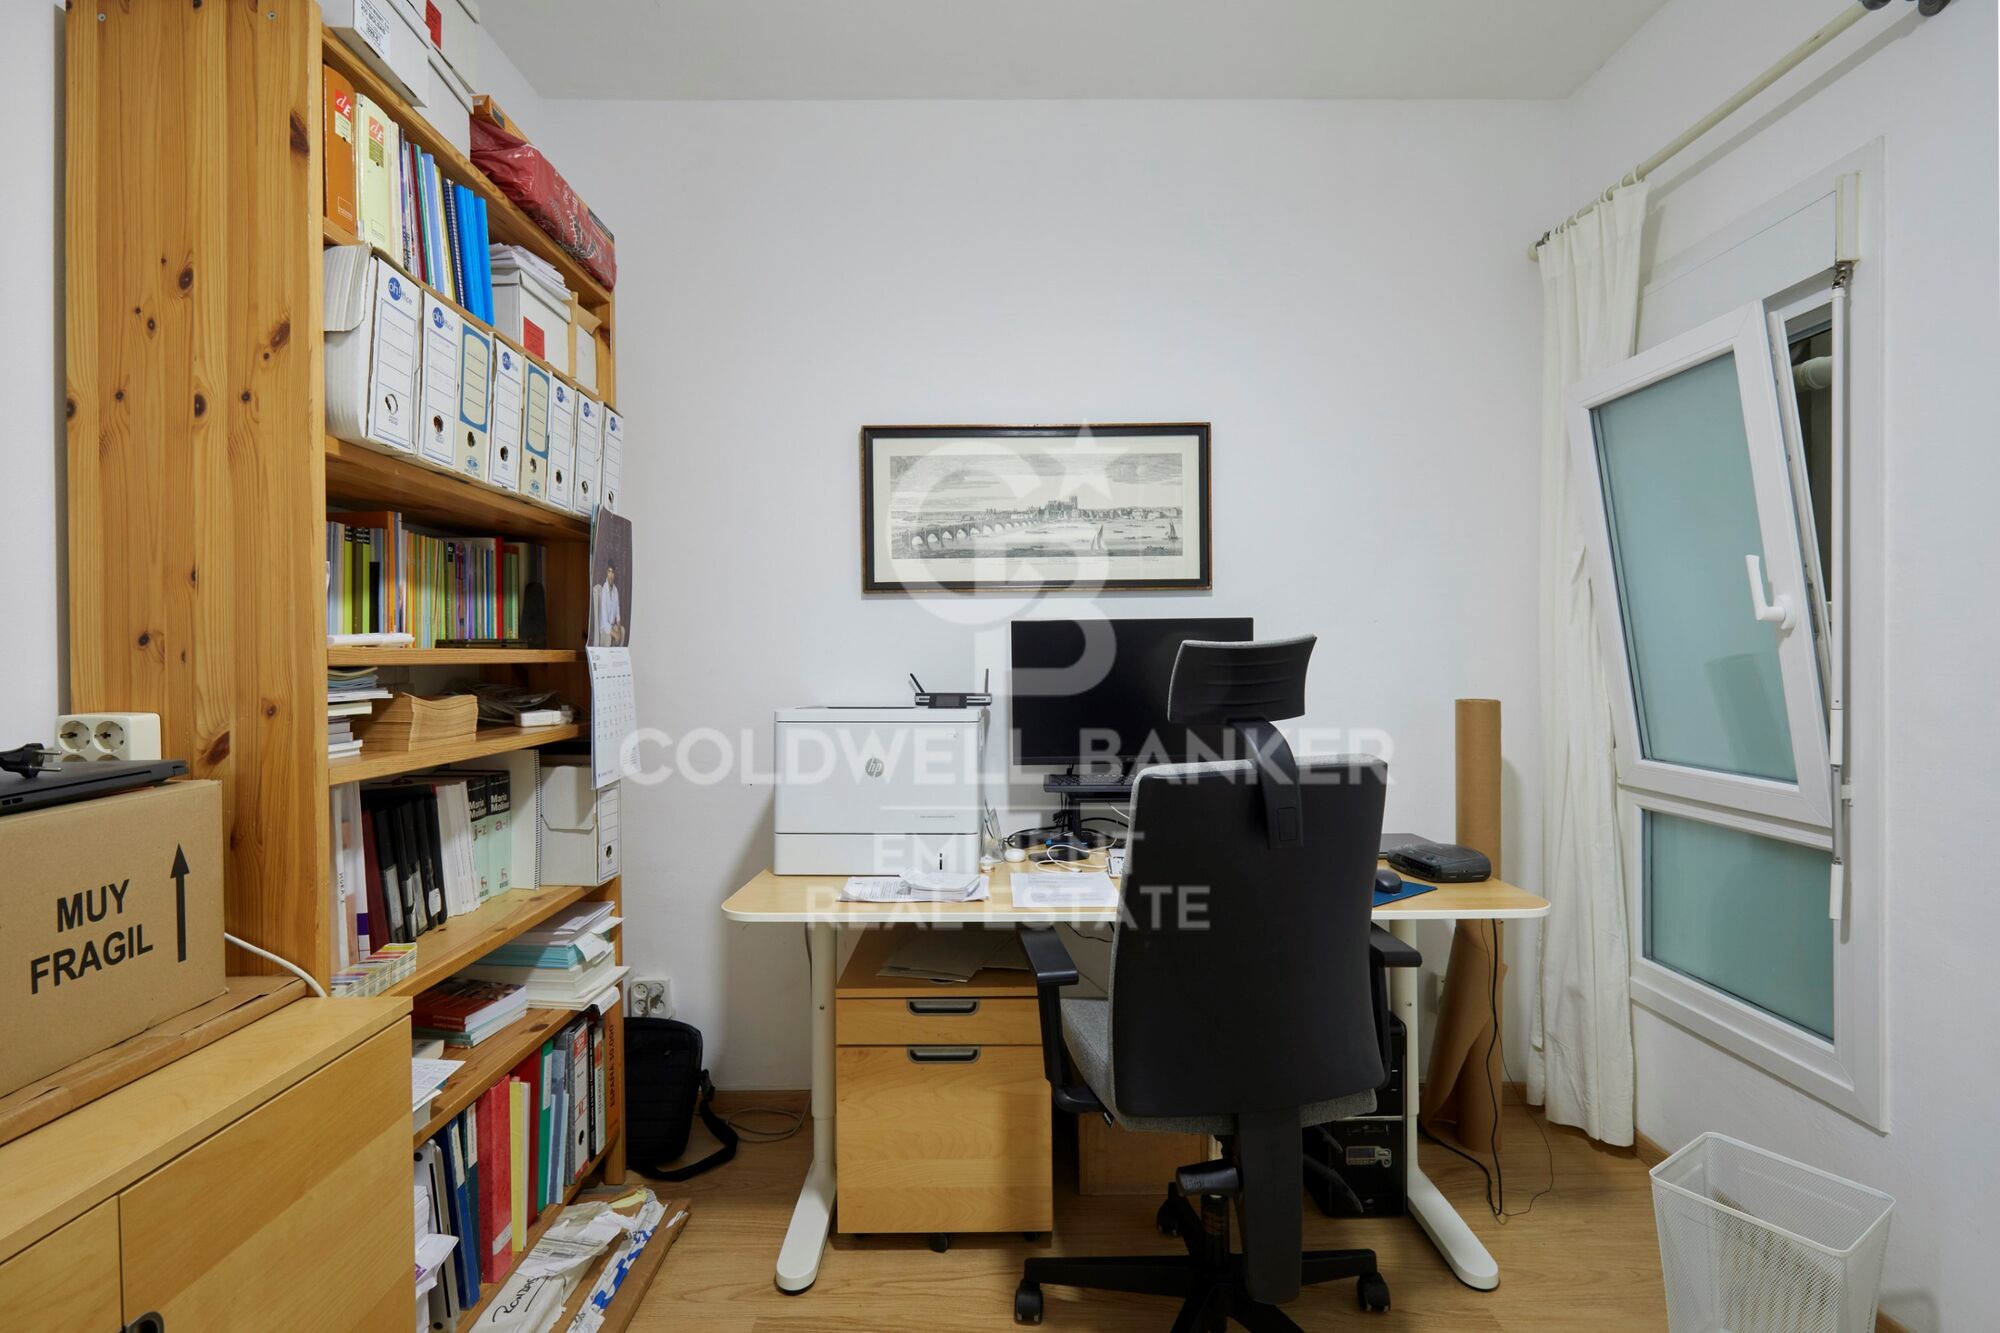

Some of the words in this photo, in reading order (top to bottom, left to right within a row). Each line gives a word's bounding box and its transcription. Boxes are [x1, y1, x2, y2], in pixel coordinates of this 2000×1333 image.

[866, 757, 884, 777] hp
[57, 879, 130, 933] MUY
[31, 924, 153, 994] FRAGIL
